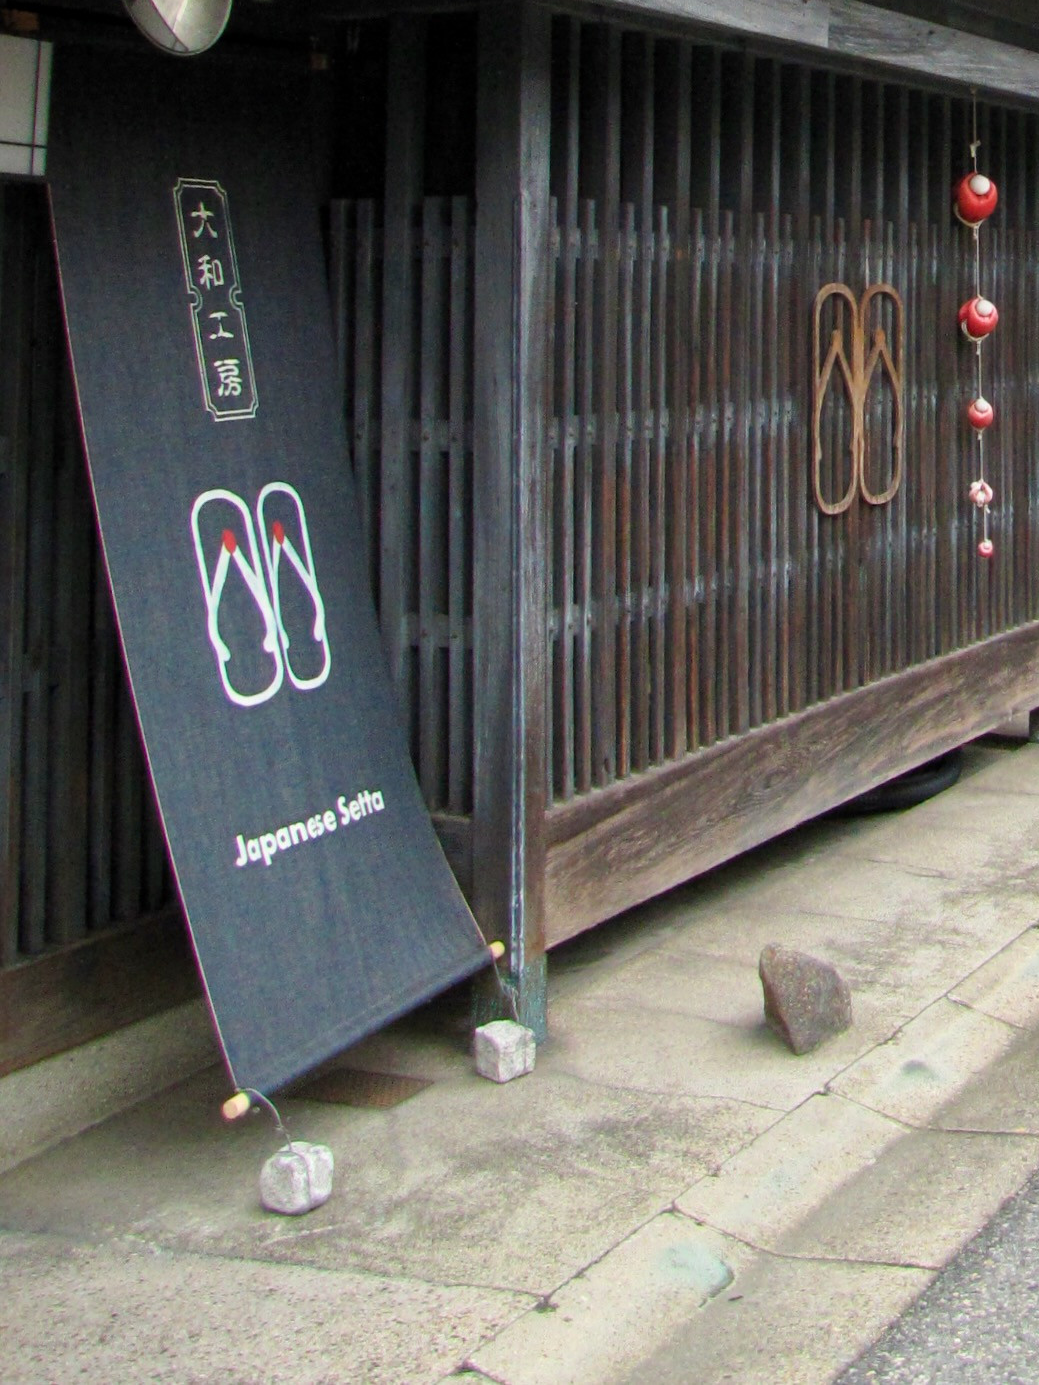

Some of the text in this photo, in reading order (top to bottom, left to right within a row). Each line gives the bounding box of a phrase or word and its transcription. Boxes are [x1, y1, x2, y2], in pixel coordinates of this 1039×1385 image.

[190, 201, 243, 397] 大和工房
[235, 790, 385, 867] Japanese Setta
